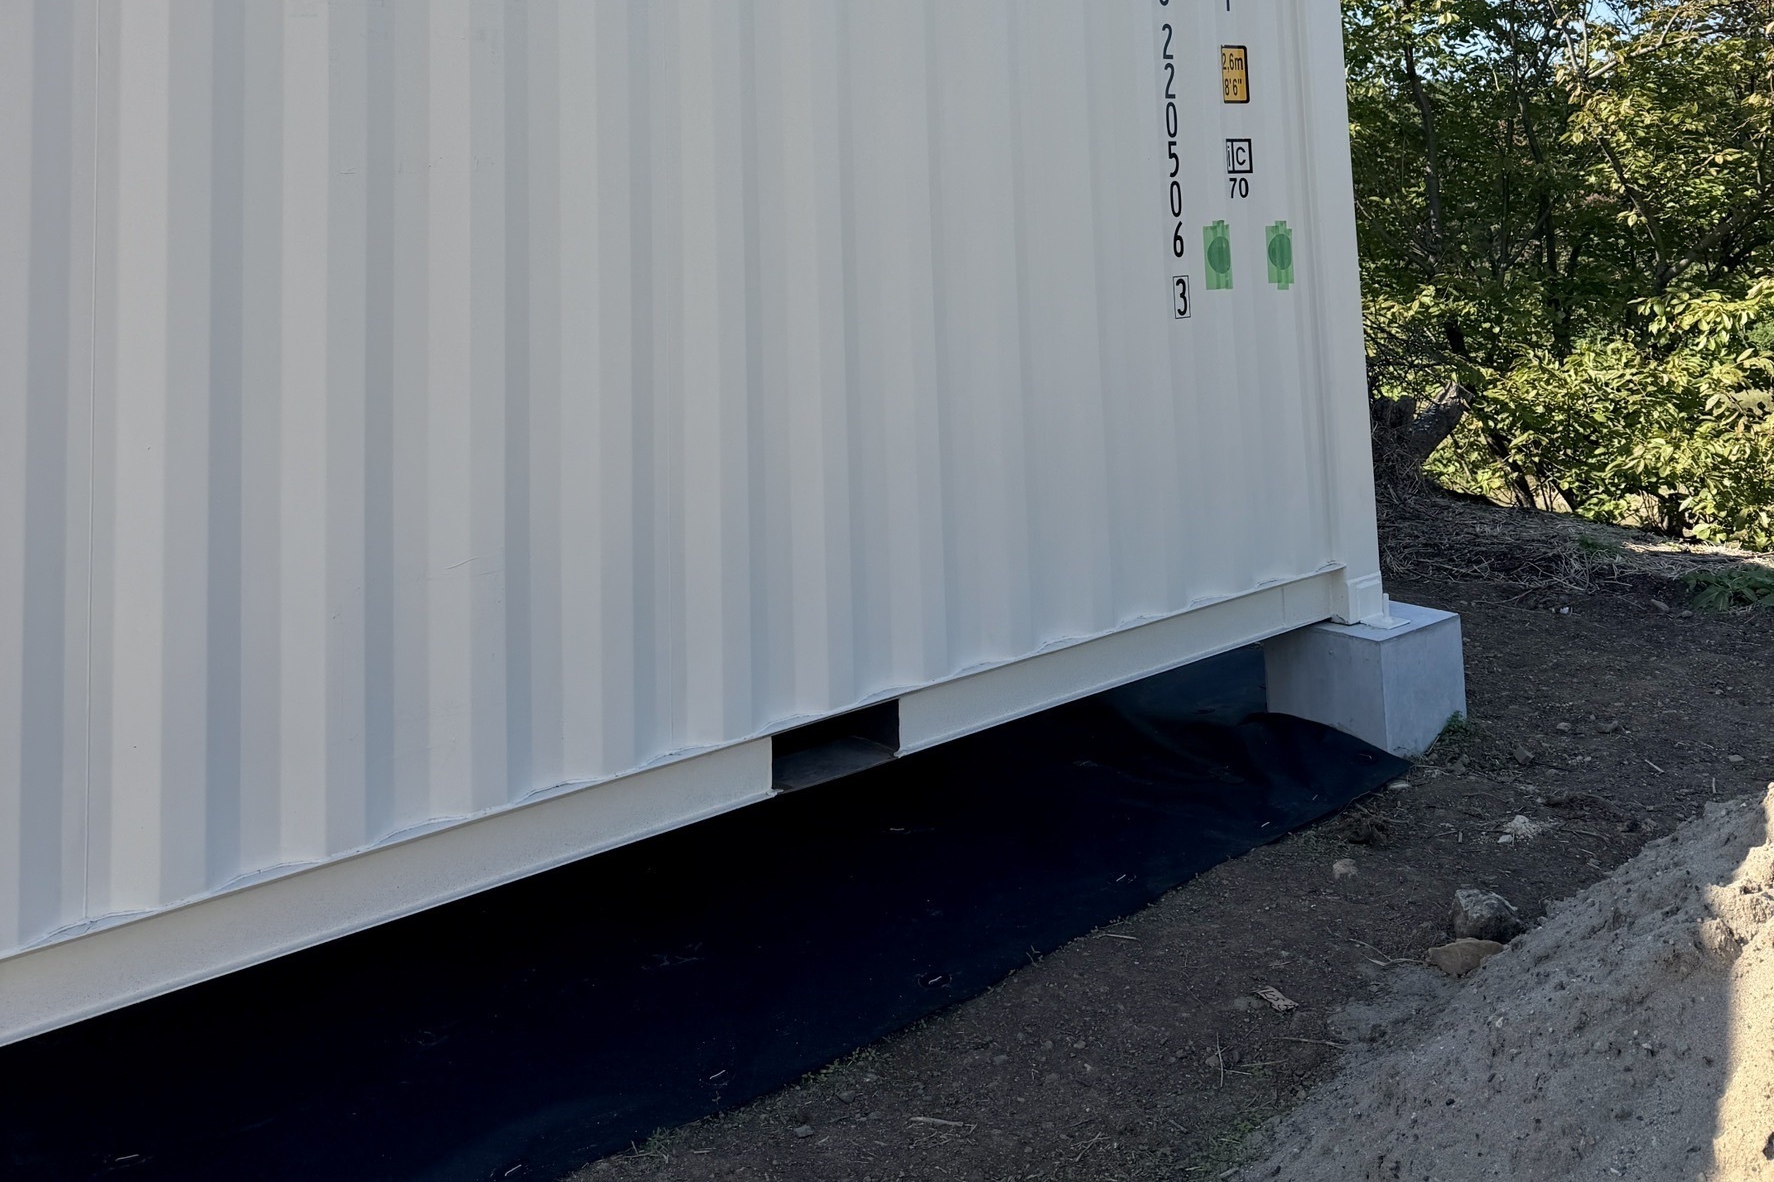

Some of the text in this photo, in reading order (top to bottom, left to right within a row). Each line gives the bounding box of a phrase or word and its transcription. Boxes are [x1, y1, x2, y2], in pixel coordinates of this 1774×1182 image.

[1162, 23, 1185, 258] 220506
[1176, 278, 1188, 316] 3
[1229, 177, 1249, 199] 70
